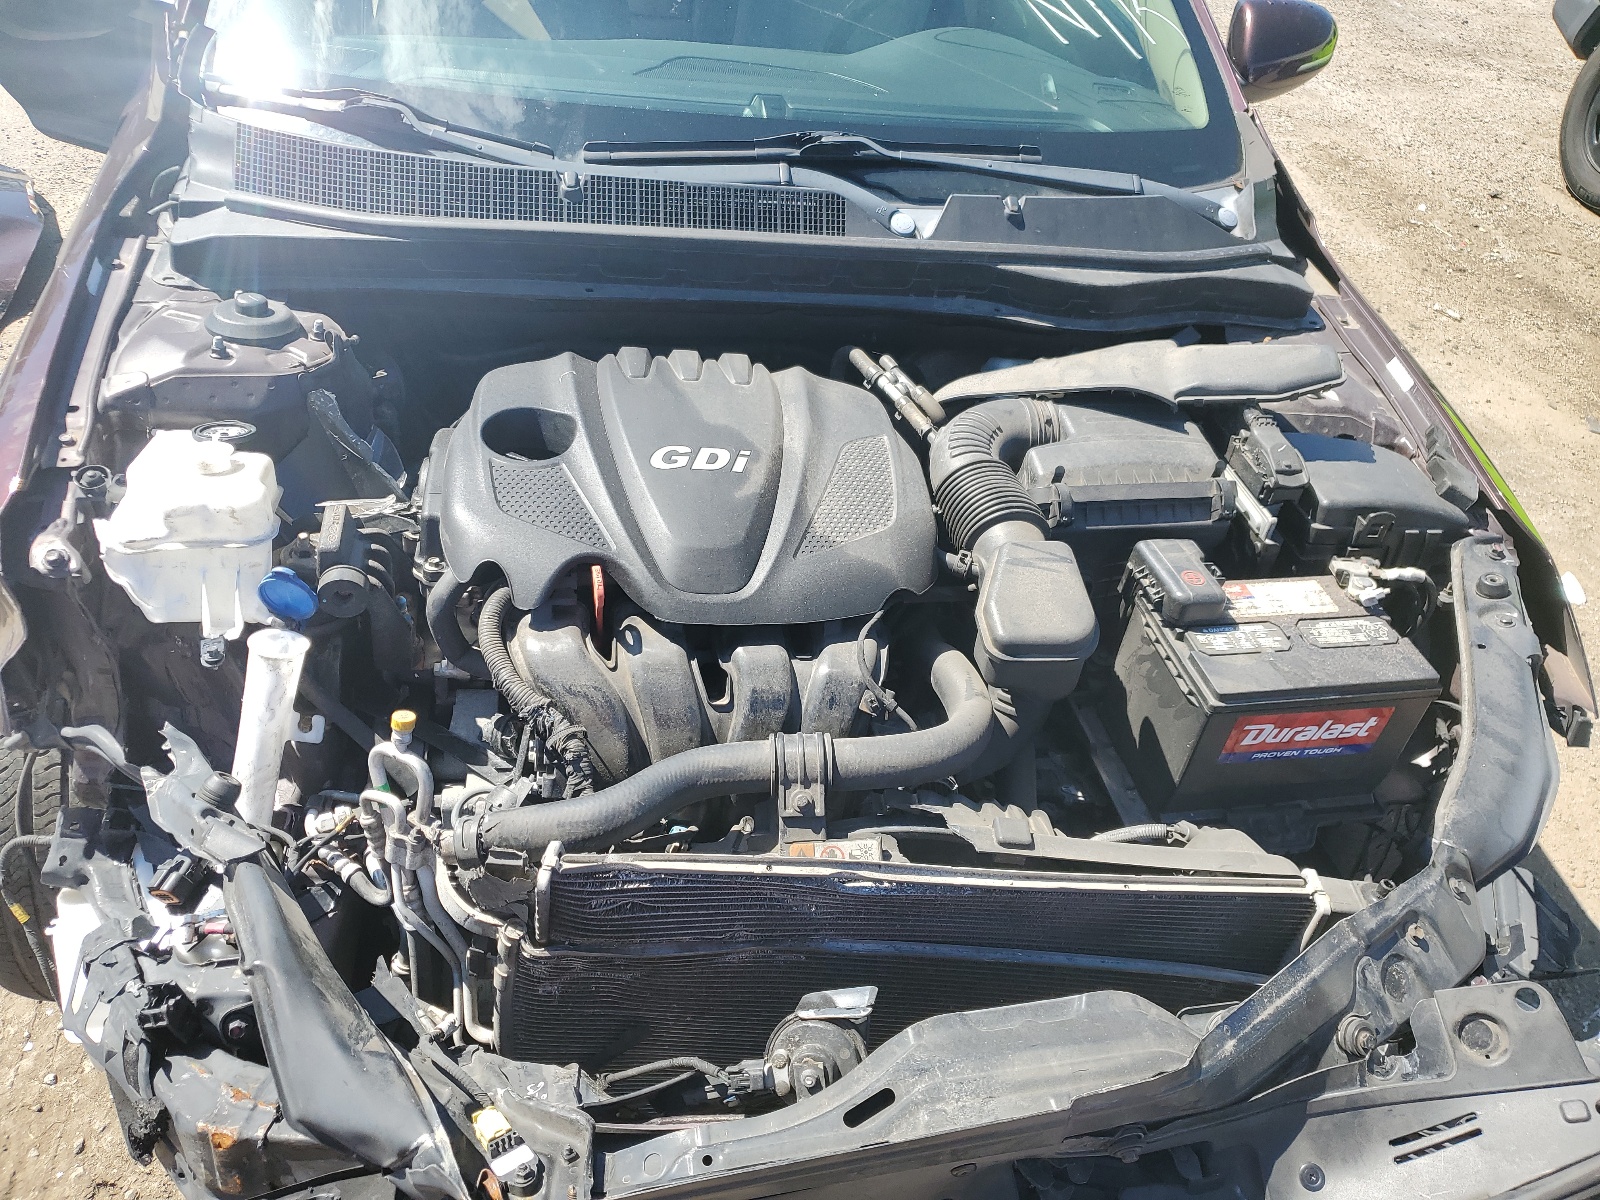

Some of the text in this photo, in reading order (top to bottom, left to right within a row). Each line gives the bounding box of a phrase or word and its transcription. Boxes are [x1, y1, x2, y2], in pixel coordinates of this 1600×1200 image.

[650, 445, 752, 473] GDi
[1240, 716, 1379, 746] Duralast
[1251, 747, 1343, 760] PROVEN TOUGH
